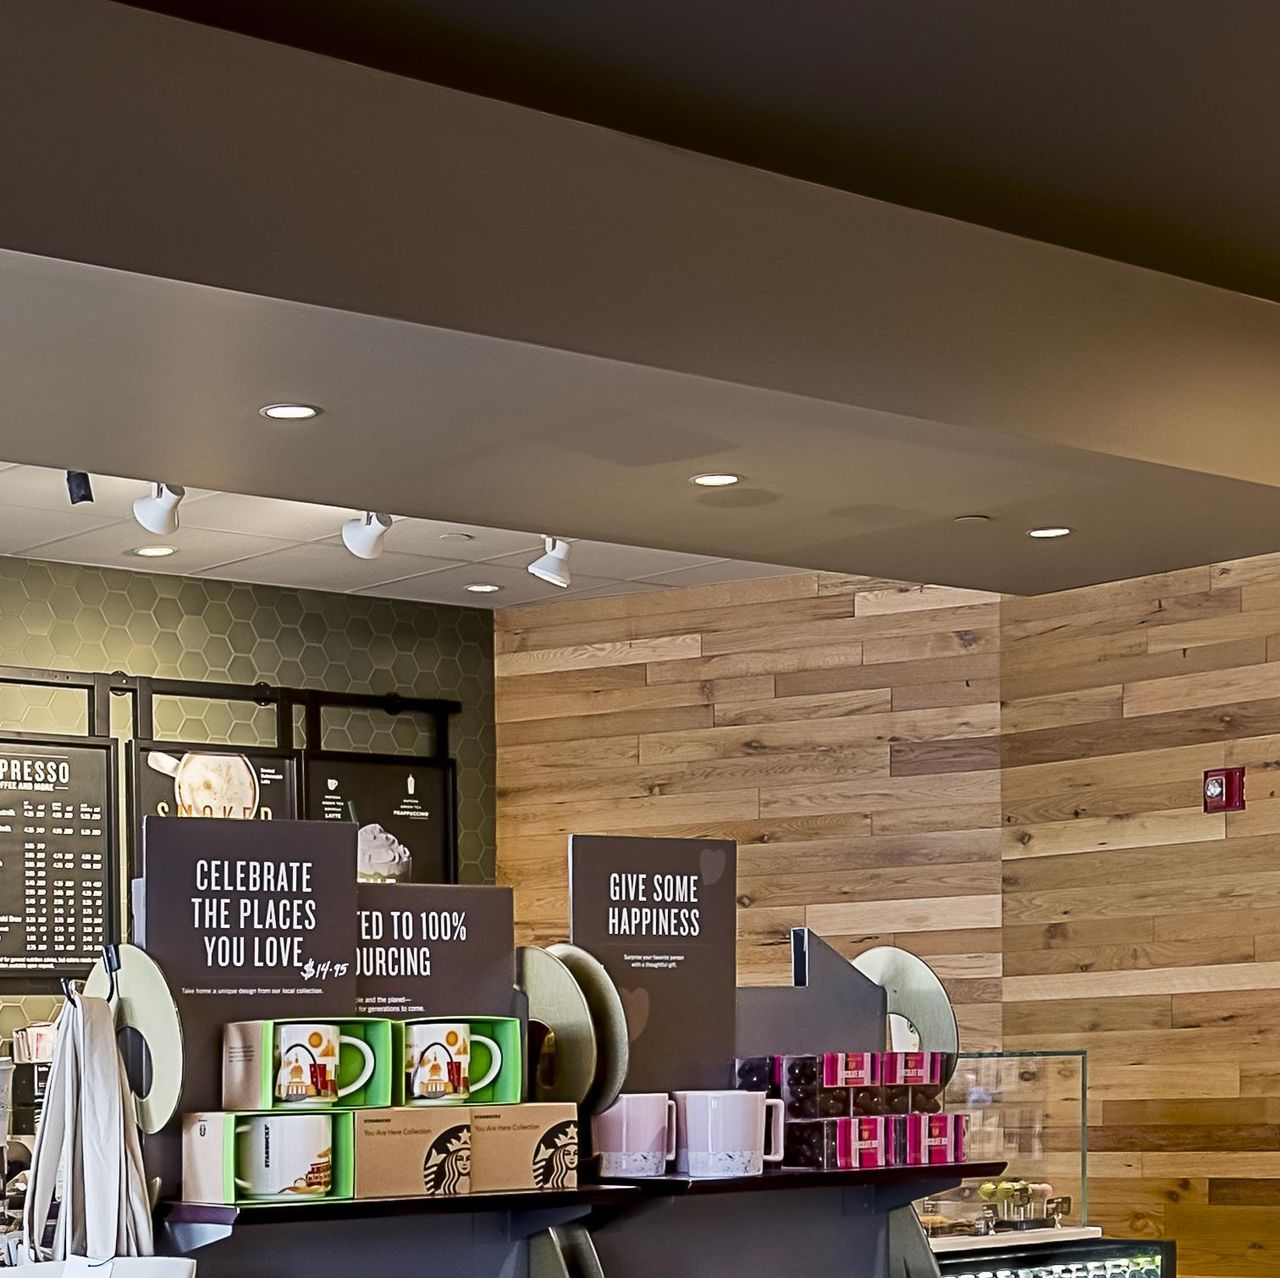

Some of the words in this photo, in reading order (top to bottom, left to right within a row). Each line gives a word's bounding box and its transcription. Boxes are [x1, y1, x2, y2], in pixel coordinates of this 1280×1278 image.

[18, 782, 33, 790] AND
[34, 783, 54, 792] MORE
[196, 859, 312, 893] CELEBRATE
[610, 872, 647, 902] GIVE
[653, 874, 699, 903] SOME
[191, 898, 231, 929] THE
[239, 898, 316, 930] PLACES
[390, 911, 413, 940] TO
[420, 911, 467, 941] 100%
[608, 907, 700, 937] HAPPINESS
[204, 936, 245, 967] YOU
[254, 936, 304, 967] LOVE
[181, 987, 195, 995] Take
[218, 988, 238, 996] unique
[238, 988, 257, 996] design
[512, 1123, 540, 1131] Collection
